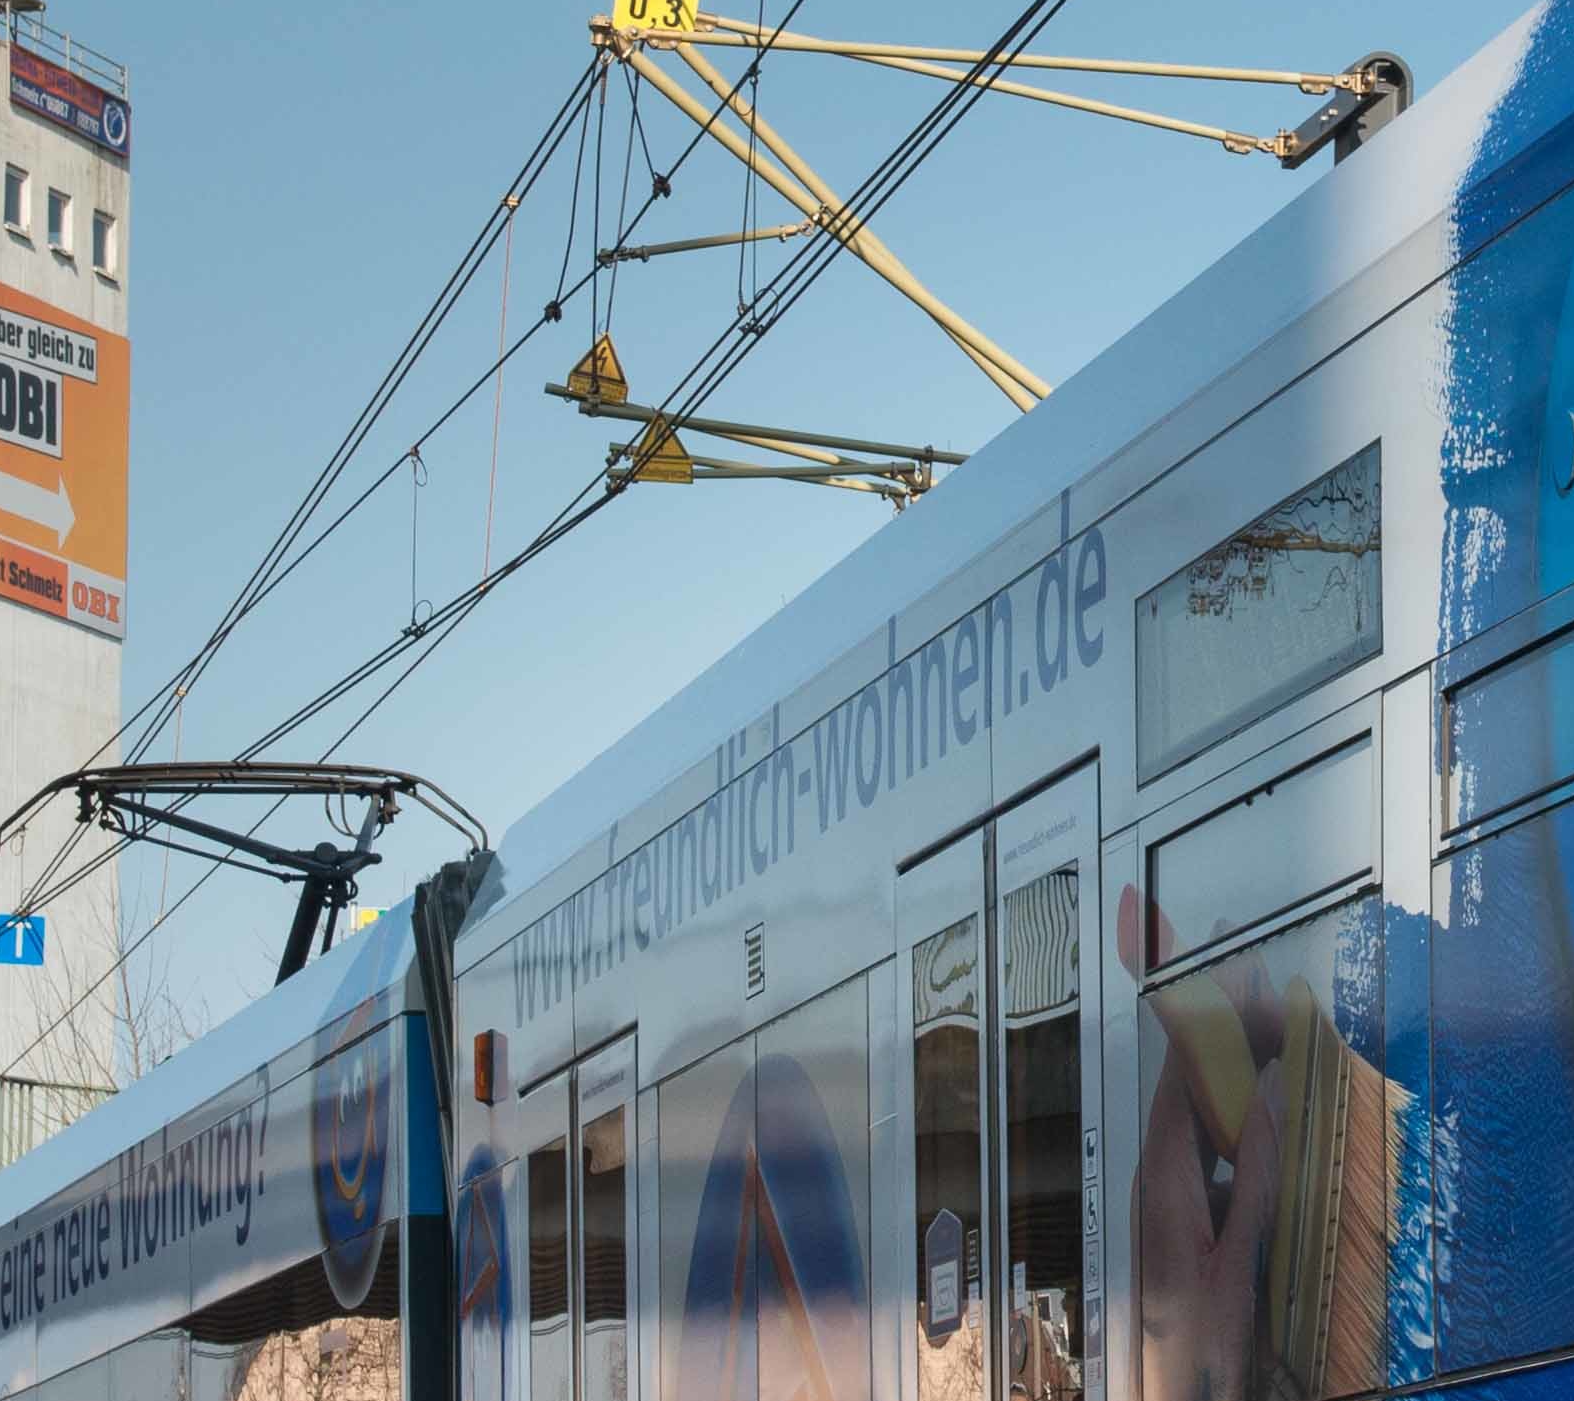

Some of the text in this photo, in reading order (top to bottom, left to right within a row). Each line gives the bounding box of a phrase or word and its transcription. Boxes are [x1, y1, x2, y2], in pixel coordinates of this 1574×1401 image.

[28, 325, 74, 365] gleich
[78, 345, 94, 371] zu
[9, 561, 63, 604] Schmelz
[73, 580, 121, 624] OBI
[514, 486, 1107, 1029] www.freundlich-wohnen.de
[1, 1216, 46, 1332] eine
[53, 1190, 111, 1303] neue
[117, 1062, 271, 1247] Wohnung?
